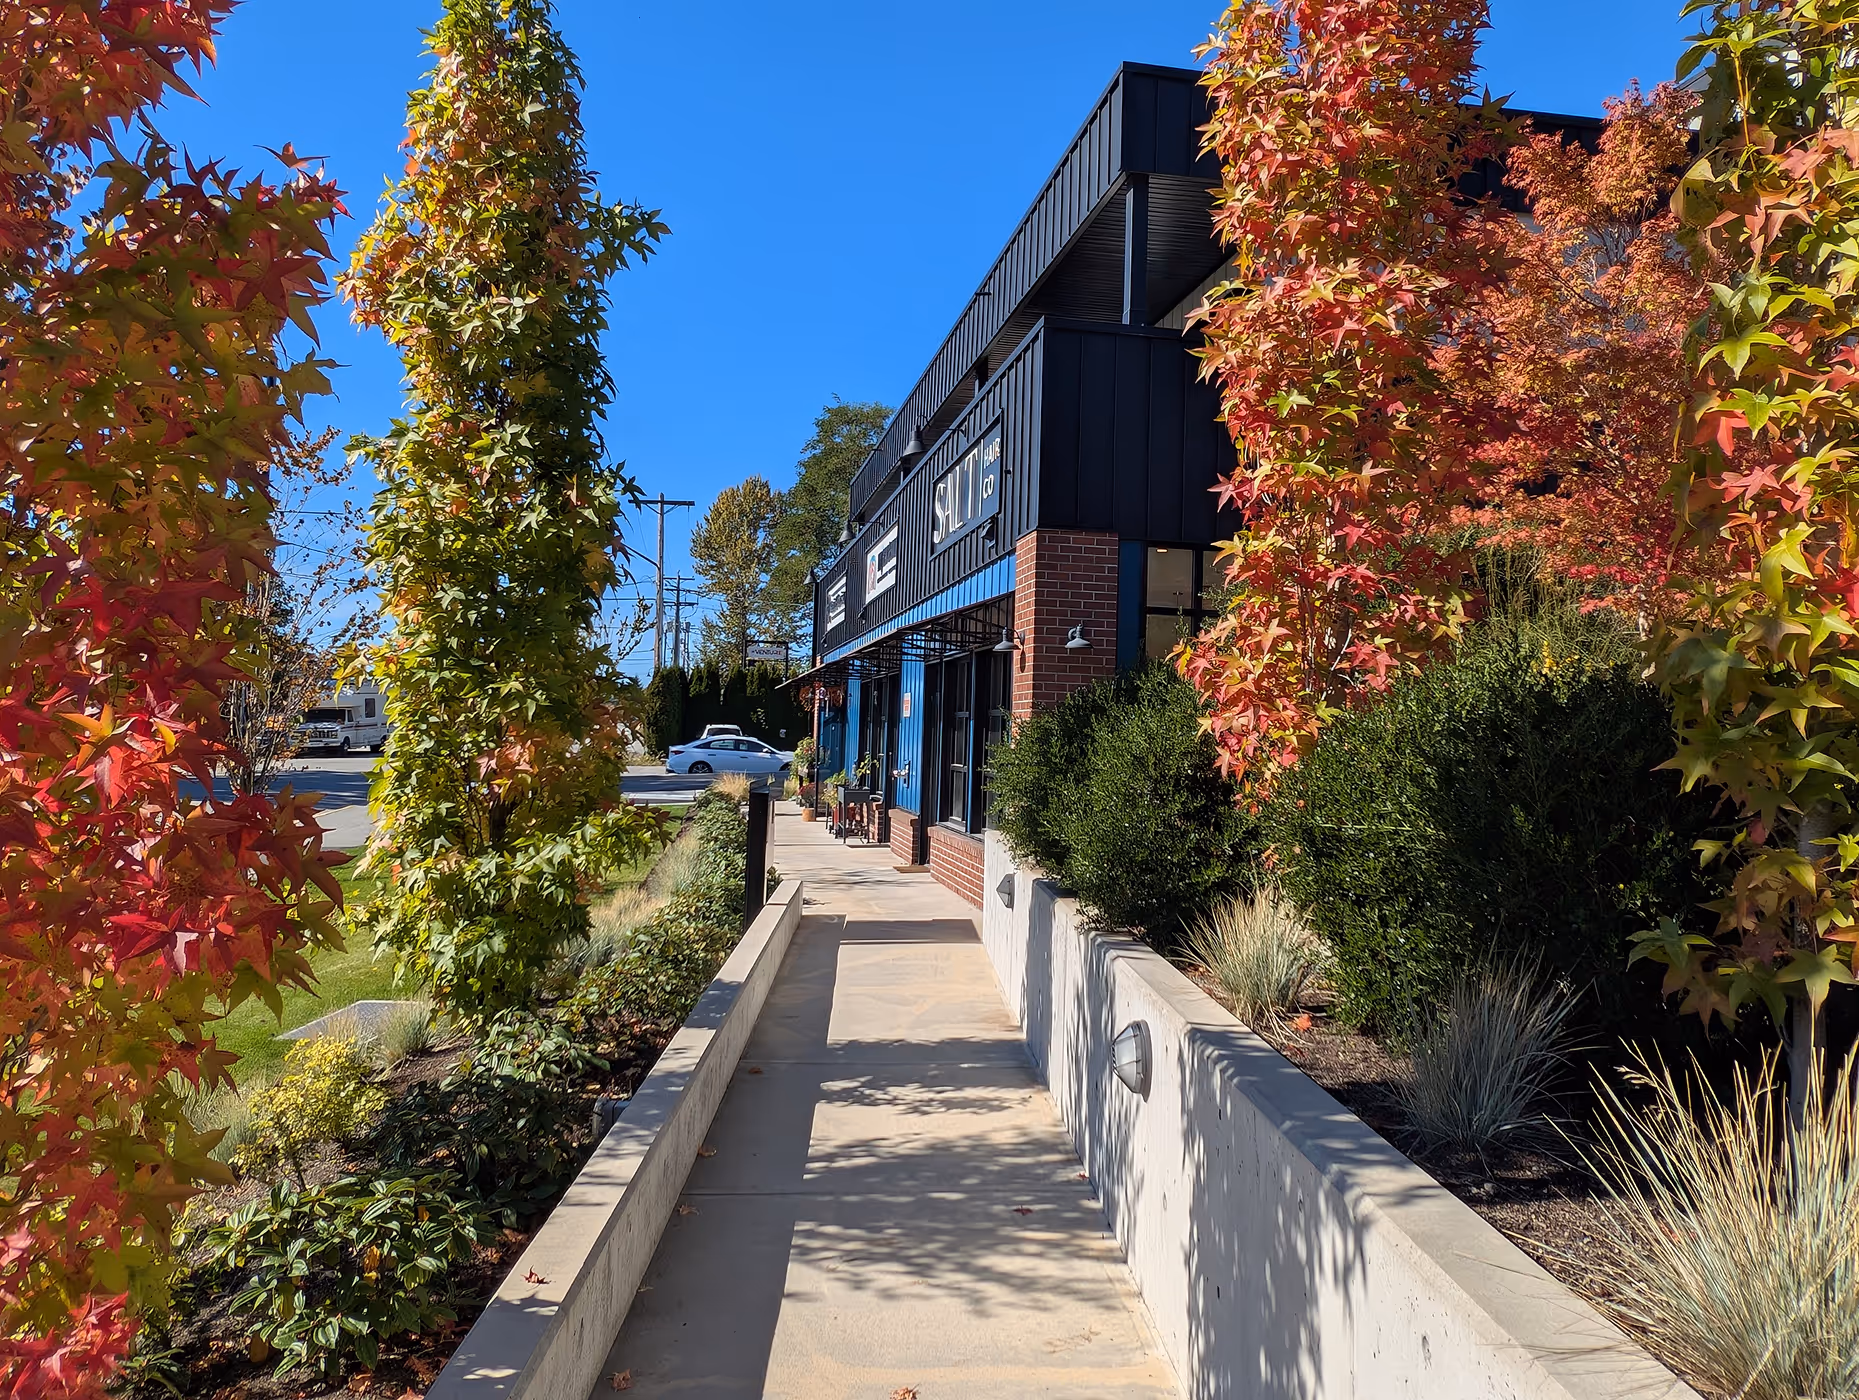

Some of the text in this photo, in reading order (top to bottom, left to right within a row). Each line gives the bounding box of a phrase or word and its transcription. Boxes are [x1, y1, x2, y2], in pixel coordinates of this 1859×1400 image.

[983, 437, 1001, 469] HAIR
[933, 447, 979, 544] SALT
[983, 474, 995, 499] CO
